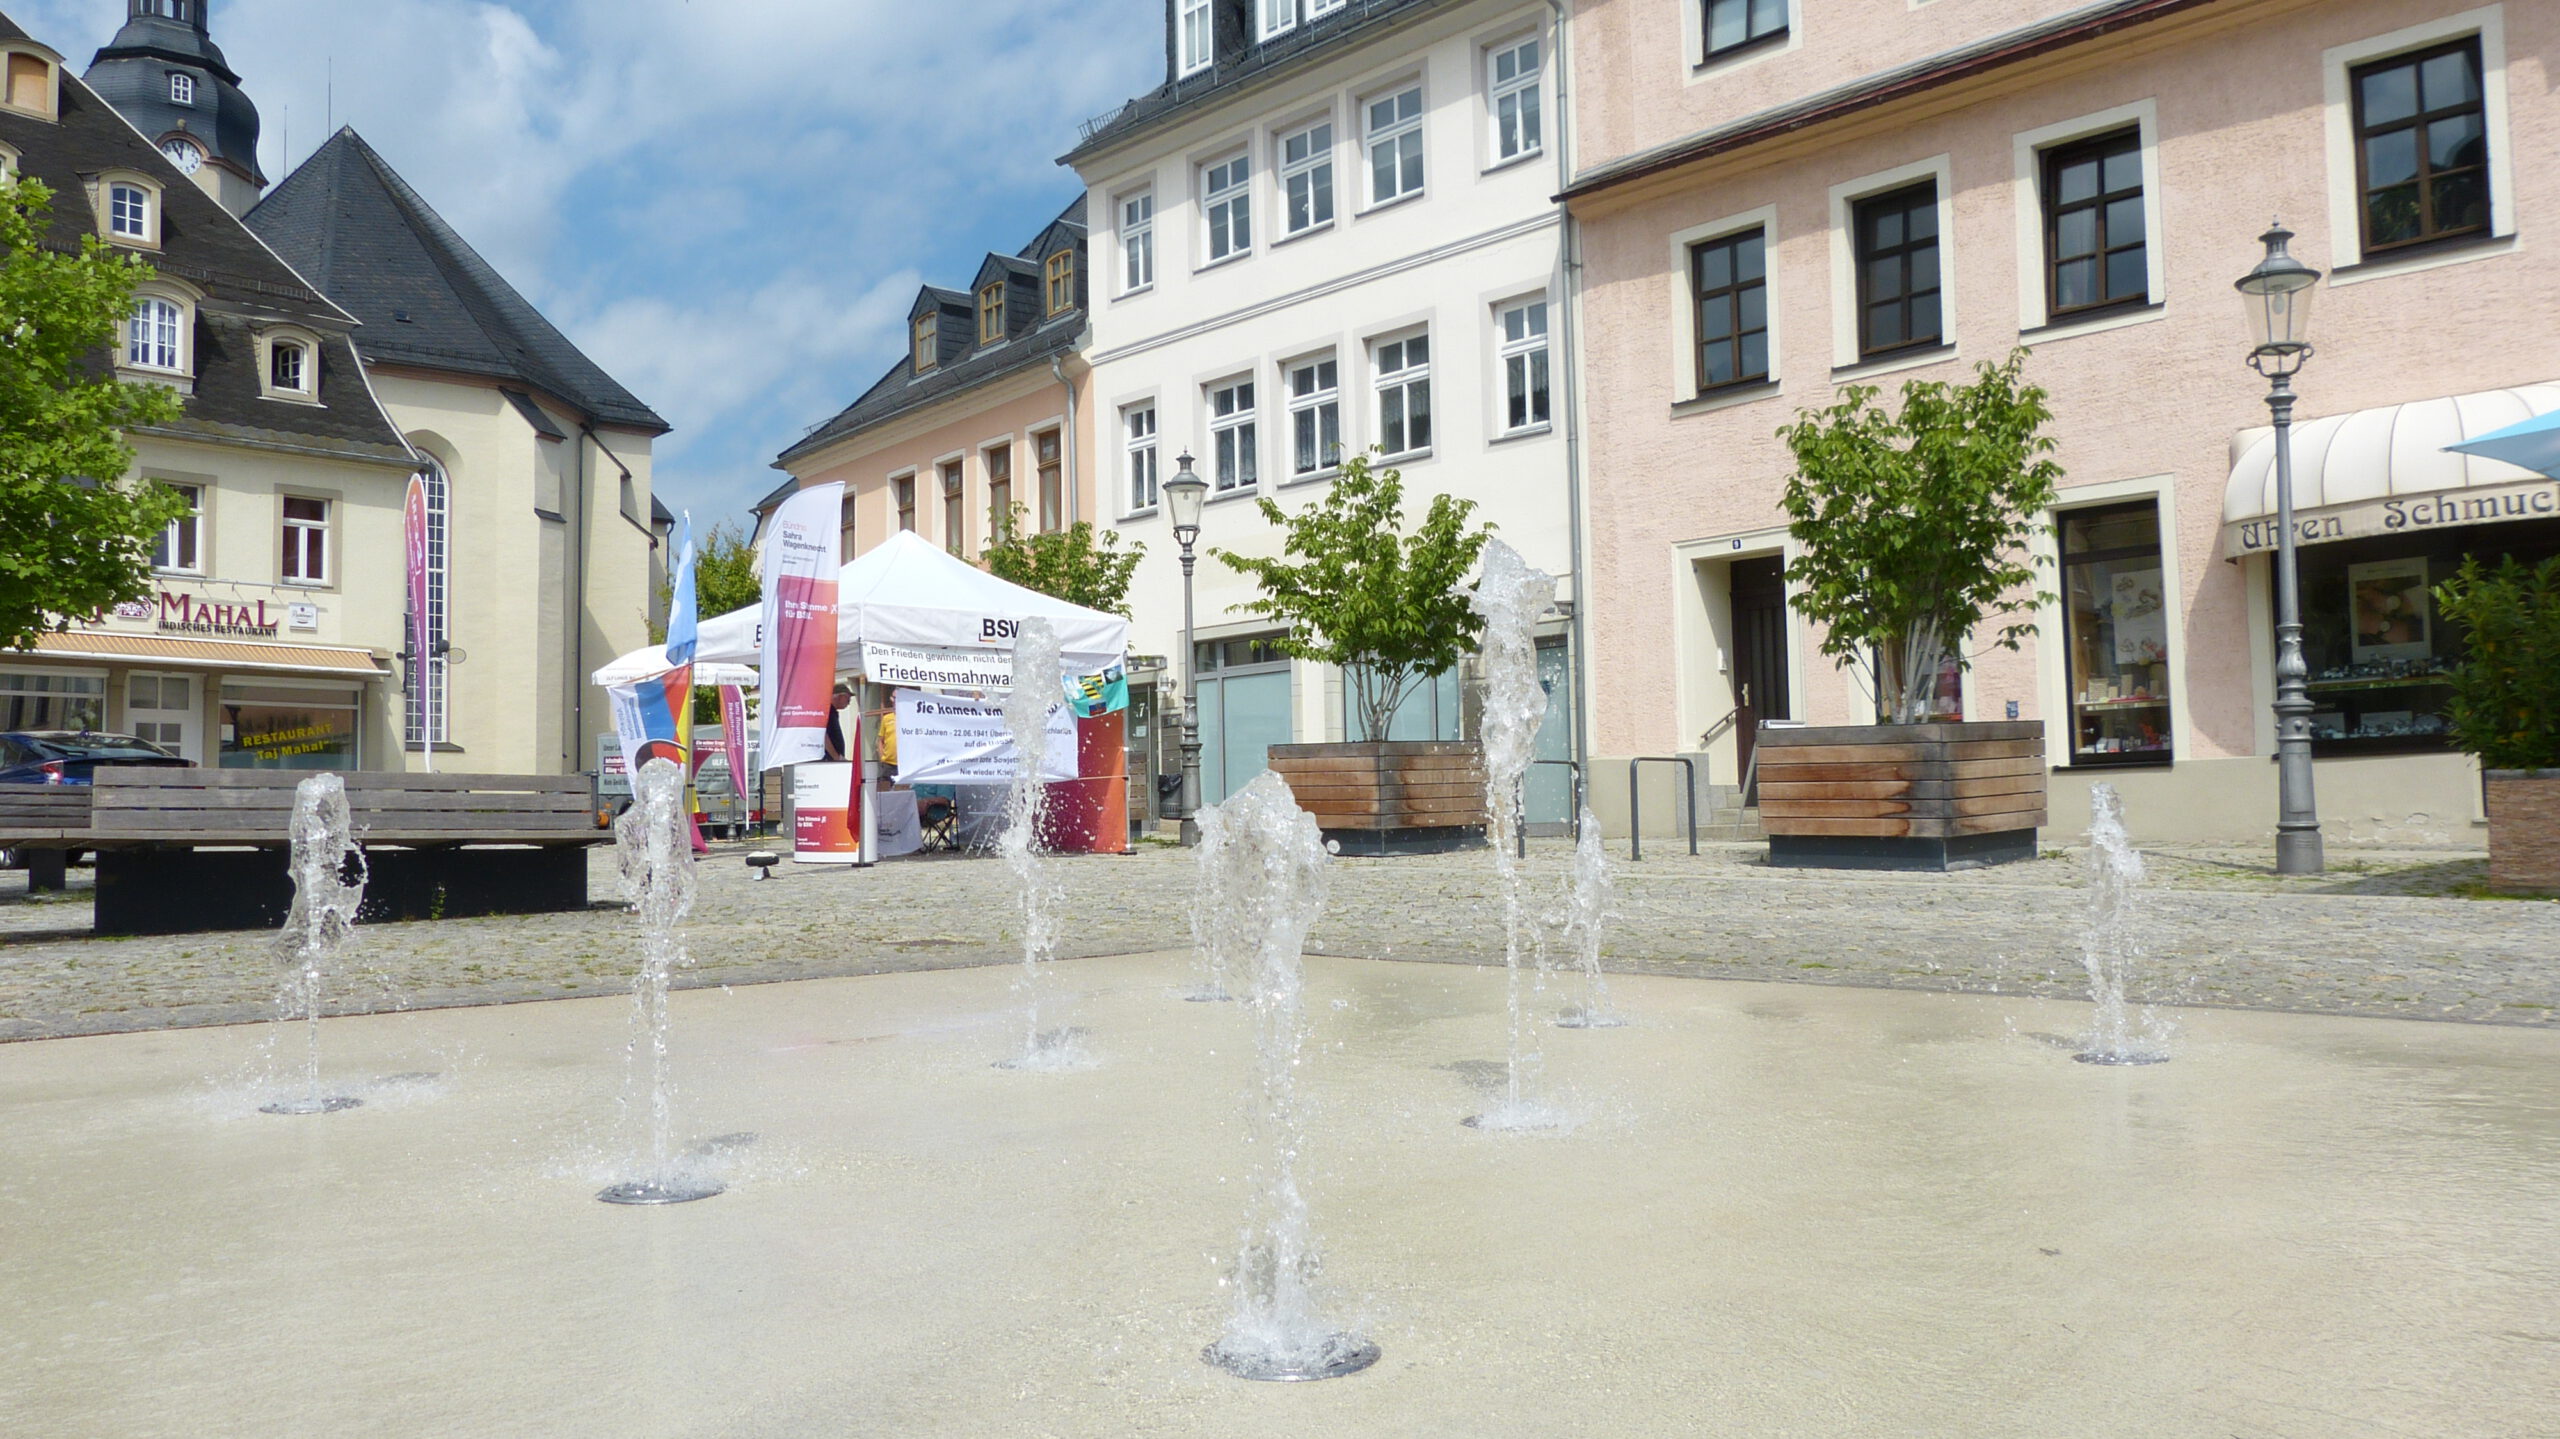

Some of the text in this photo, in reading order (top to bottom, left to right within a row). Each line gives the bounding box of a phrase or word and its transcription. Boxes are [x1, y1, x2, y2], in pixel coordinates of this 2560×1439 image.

[782, 530, 802, 541] Sahra
[782, 539, 827, 553] Wagenknecht
[159, 591, 280, 628] MAHAL
[158, 620, 279, 639] INDISCHES RESTAURANT
[891, 647, 924, 660] Frieden
[973, 653, 996, 664] nicht
[879, 662, 1014, 686] Friedensmahnwa
[916, 701, 934, 714] Sie
[984, 707, 1003, 717] um
[1138, 702, 1146, 719] 7
[242, 723, 333, 748] RESTAURANT
[901, 728, 913, 736] Vor
[924, 728, 948, 737] Jahren
[953, 729, 988, 738] 22.06.1941
[964, 740, 975, 748] auf
[976, 740, 987, 748] die
[960, 768, 972, 776] Nie
[973, 768, 995, 777] wieder
